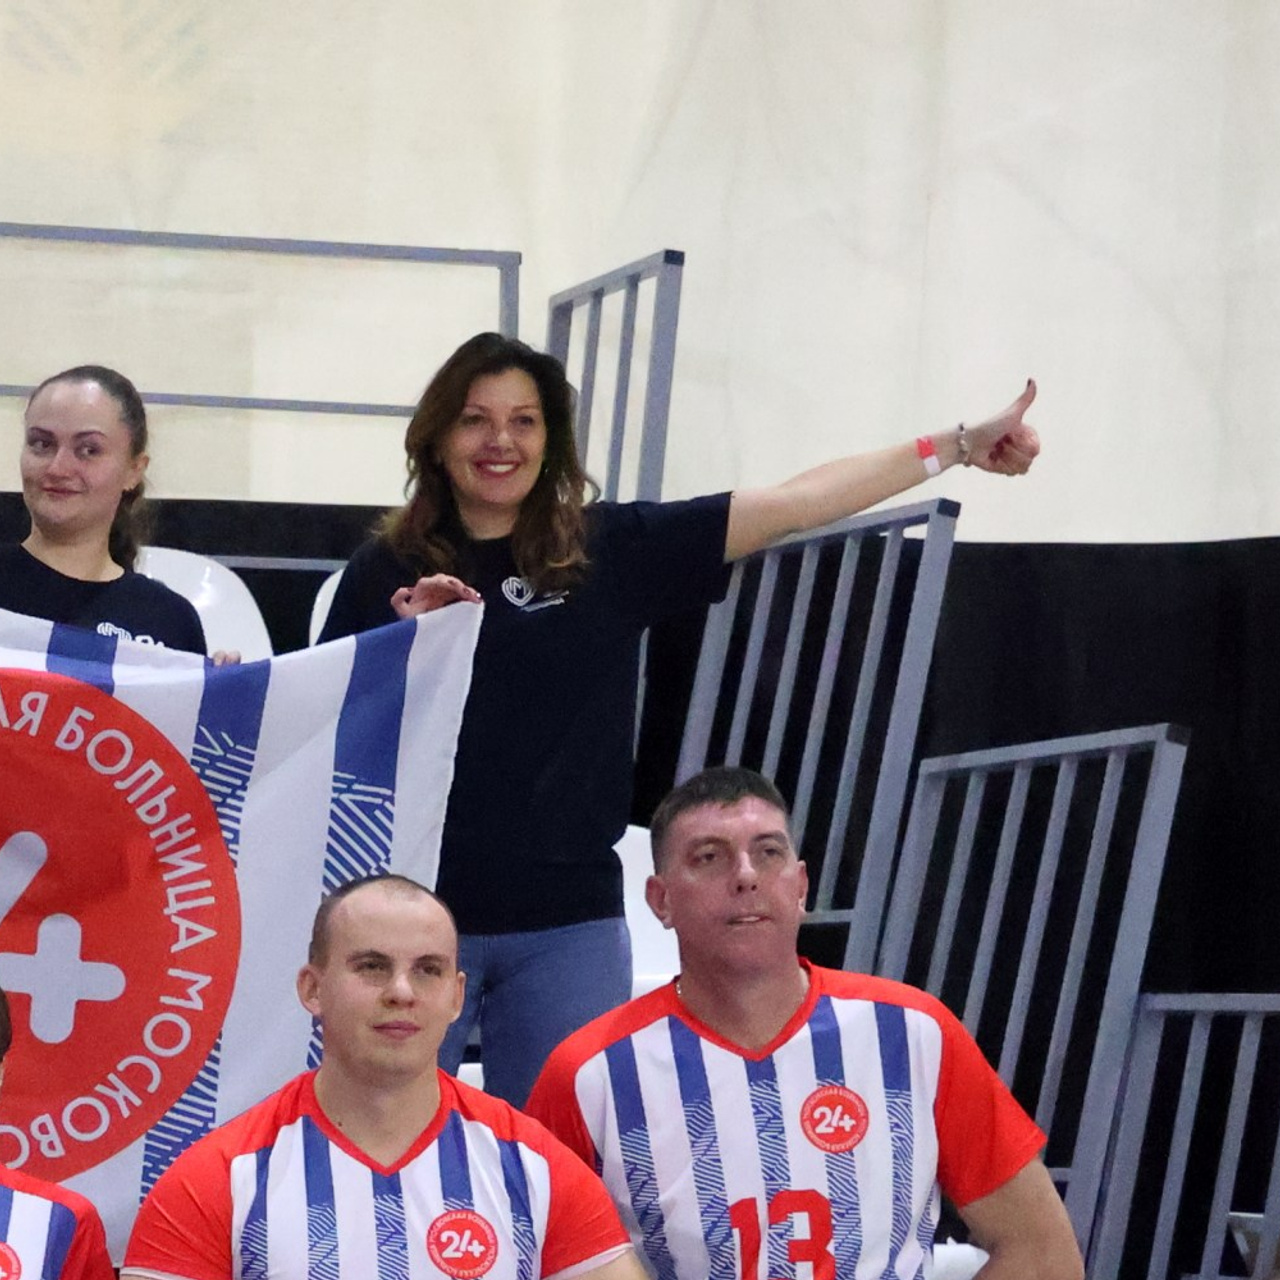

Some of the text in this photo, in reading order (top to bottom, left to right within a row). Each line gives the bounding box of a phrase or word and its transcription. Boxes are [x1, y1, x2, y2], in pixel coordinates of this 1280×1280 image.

[55, 707, 217, 952] БОЛЬНИЦА
[813, 1104, 857, 1134] 24
[440, 1229, 487, 1259] 24
